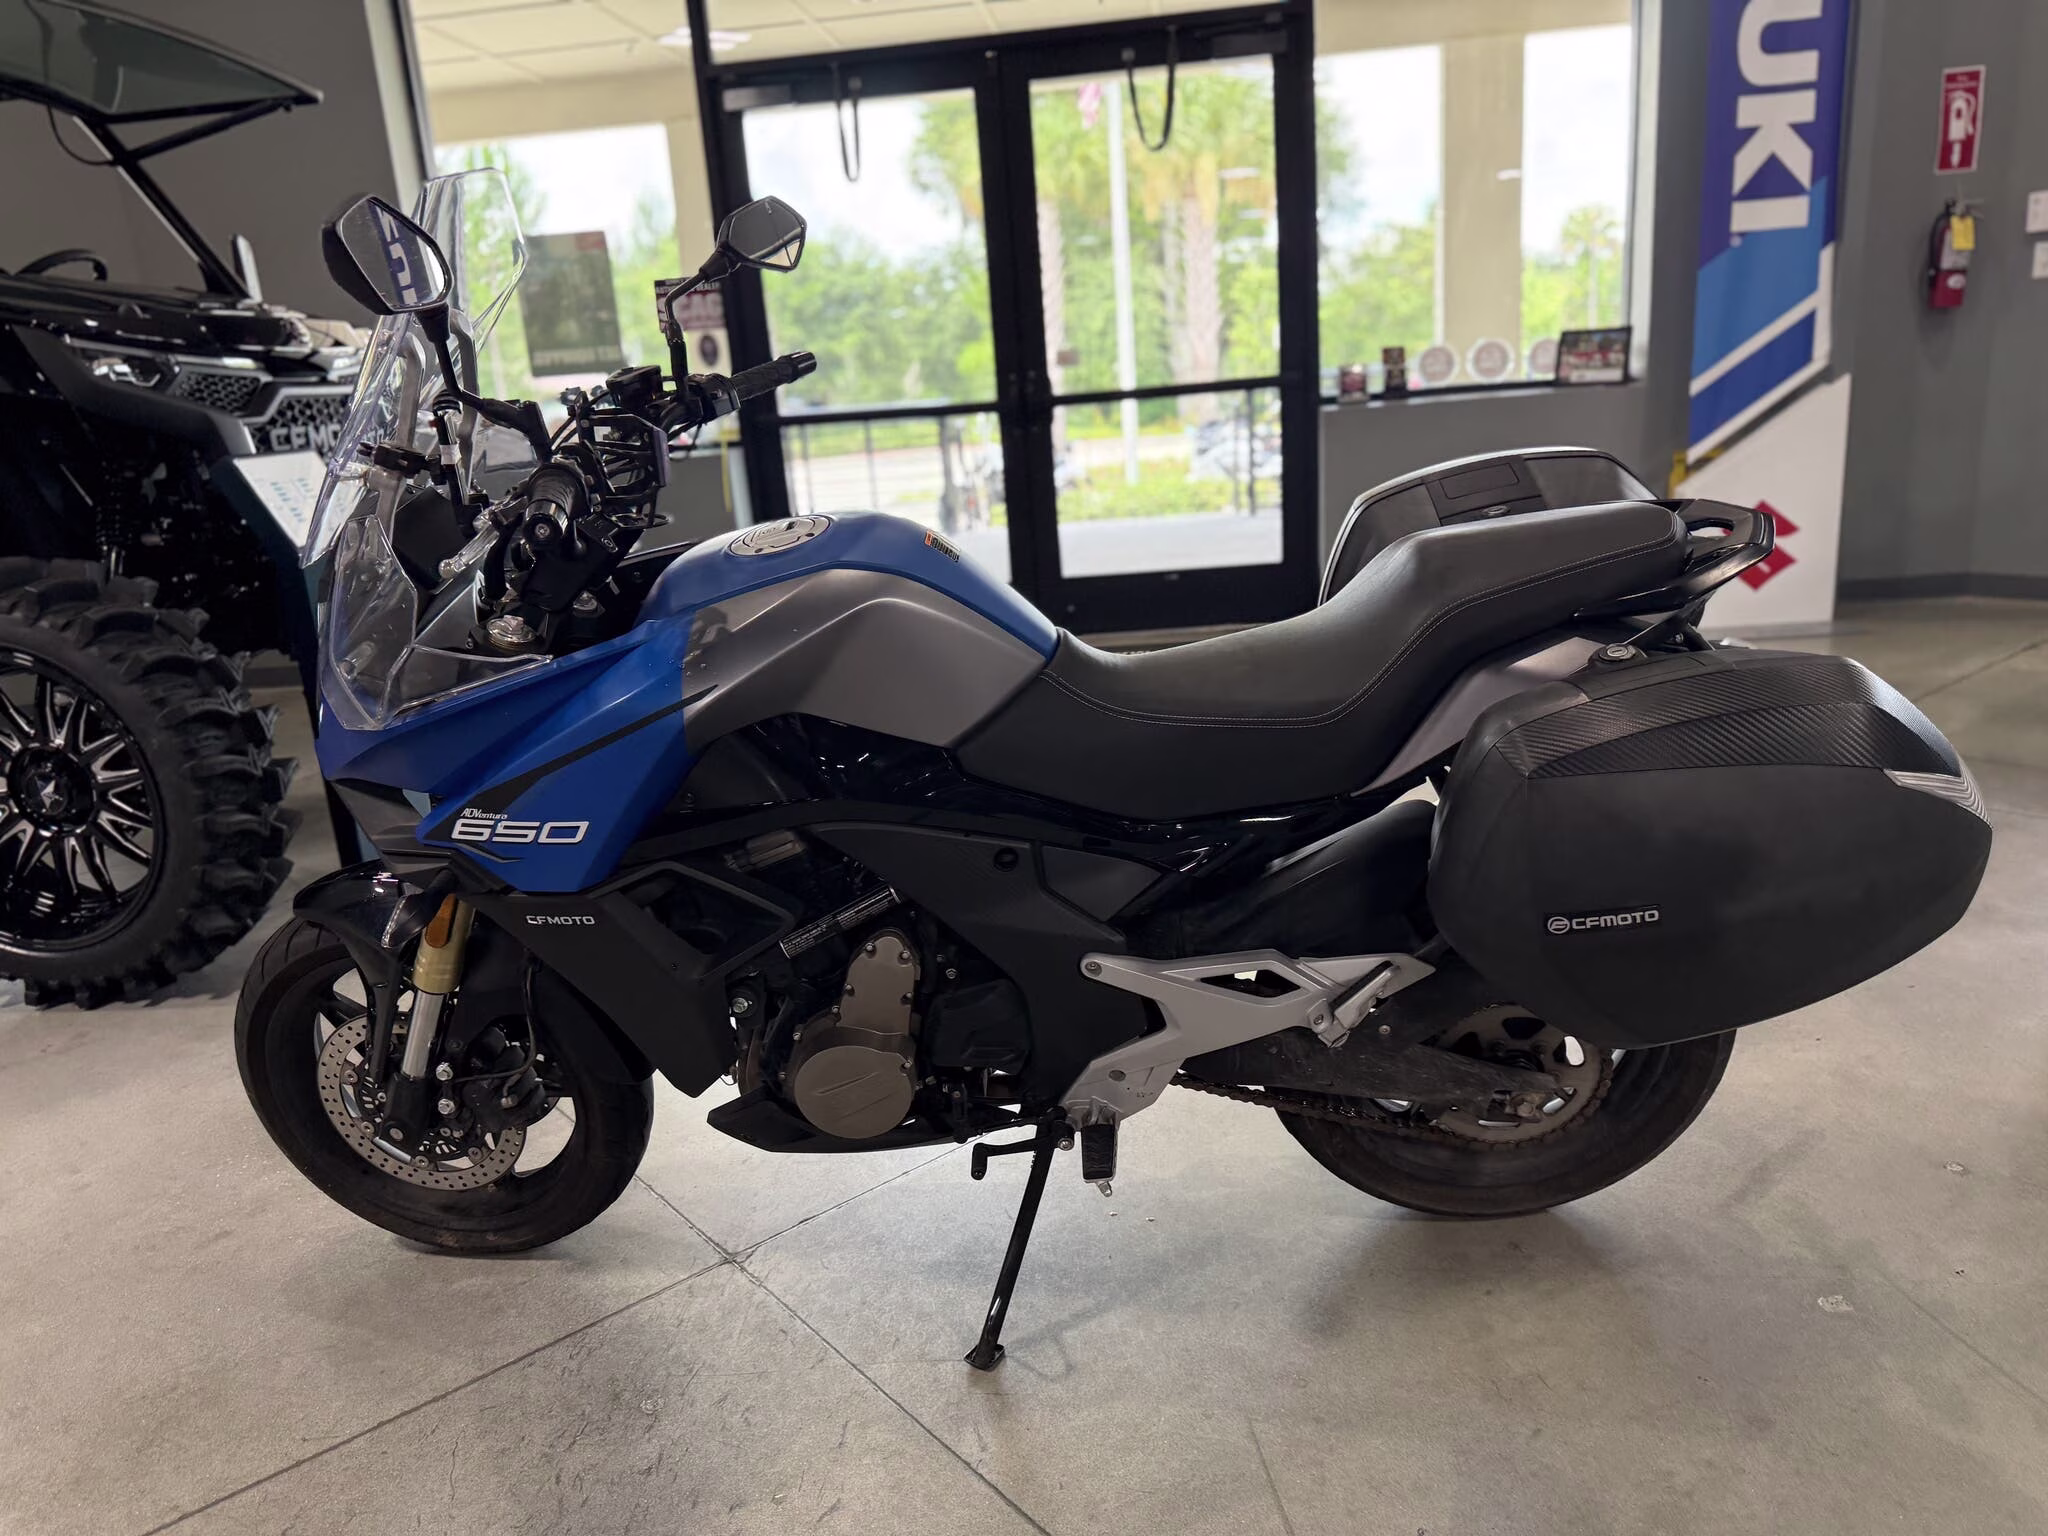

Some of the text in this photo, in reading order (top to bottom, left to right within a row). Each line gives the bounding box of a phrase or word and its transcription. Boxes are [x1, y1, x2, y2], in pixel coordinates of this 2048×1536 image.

[1730, 0, 1823, 233] UKI
[460, 807, 508, 819] ADVentura
[451, 818, 590, 844] 650
[525, 914, 596, 925] CFMOTO
[1571, 909, 1660, 929] CFMOTO
